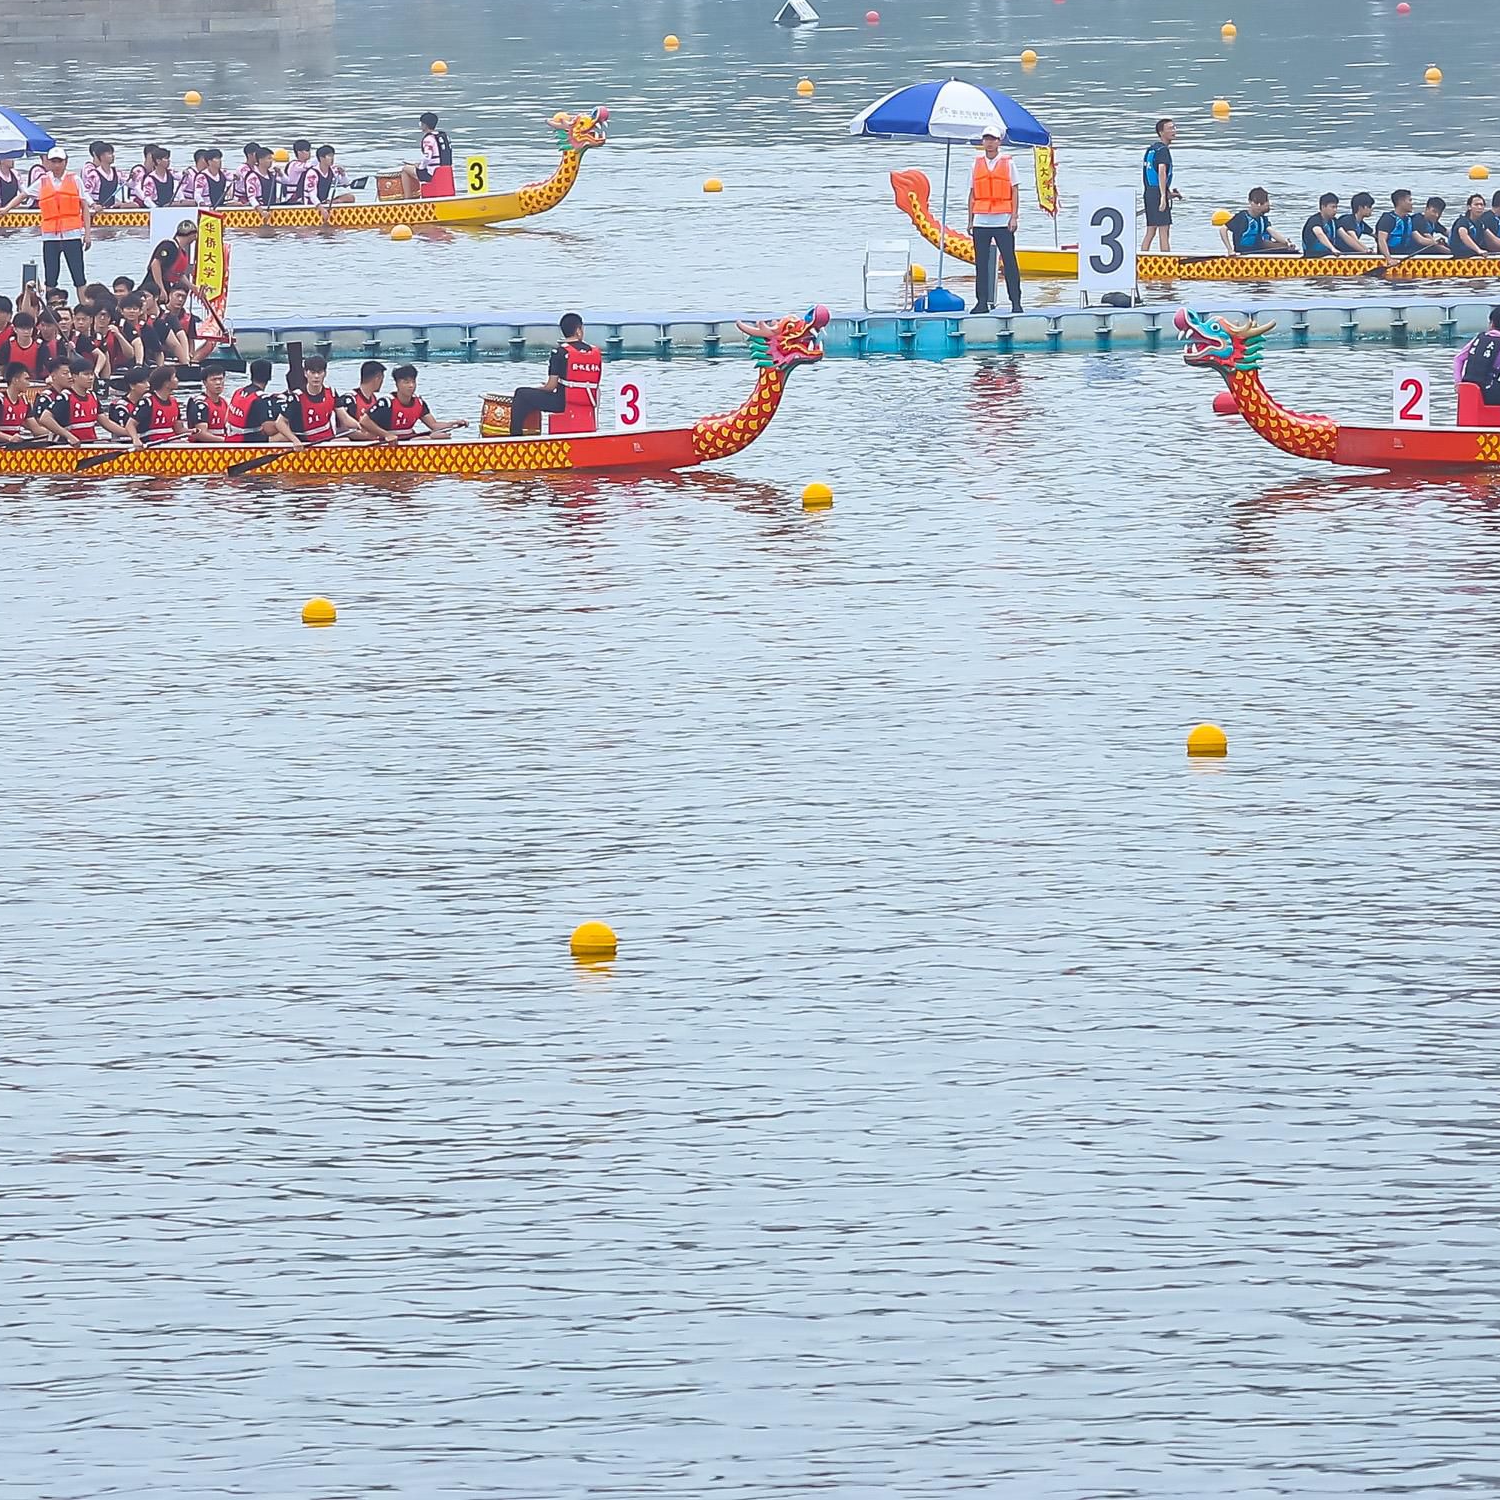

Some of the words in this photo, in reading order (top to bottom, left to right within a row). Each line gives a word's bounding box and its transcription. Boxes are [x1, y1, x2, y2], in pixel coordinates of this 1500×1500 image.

[470, 162, 483, 191] 3
[1038, 147, 1053, 190] 门大学
[203, 222, 217, 278] 华侨大学
[1089, 207, 1124, 274] 3
[620, 383, 640, 425] 3
[1399, 378, 1423, 420] 2
